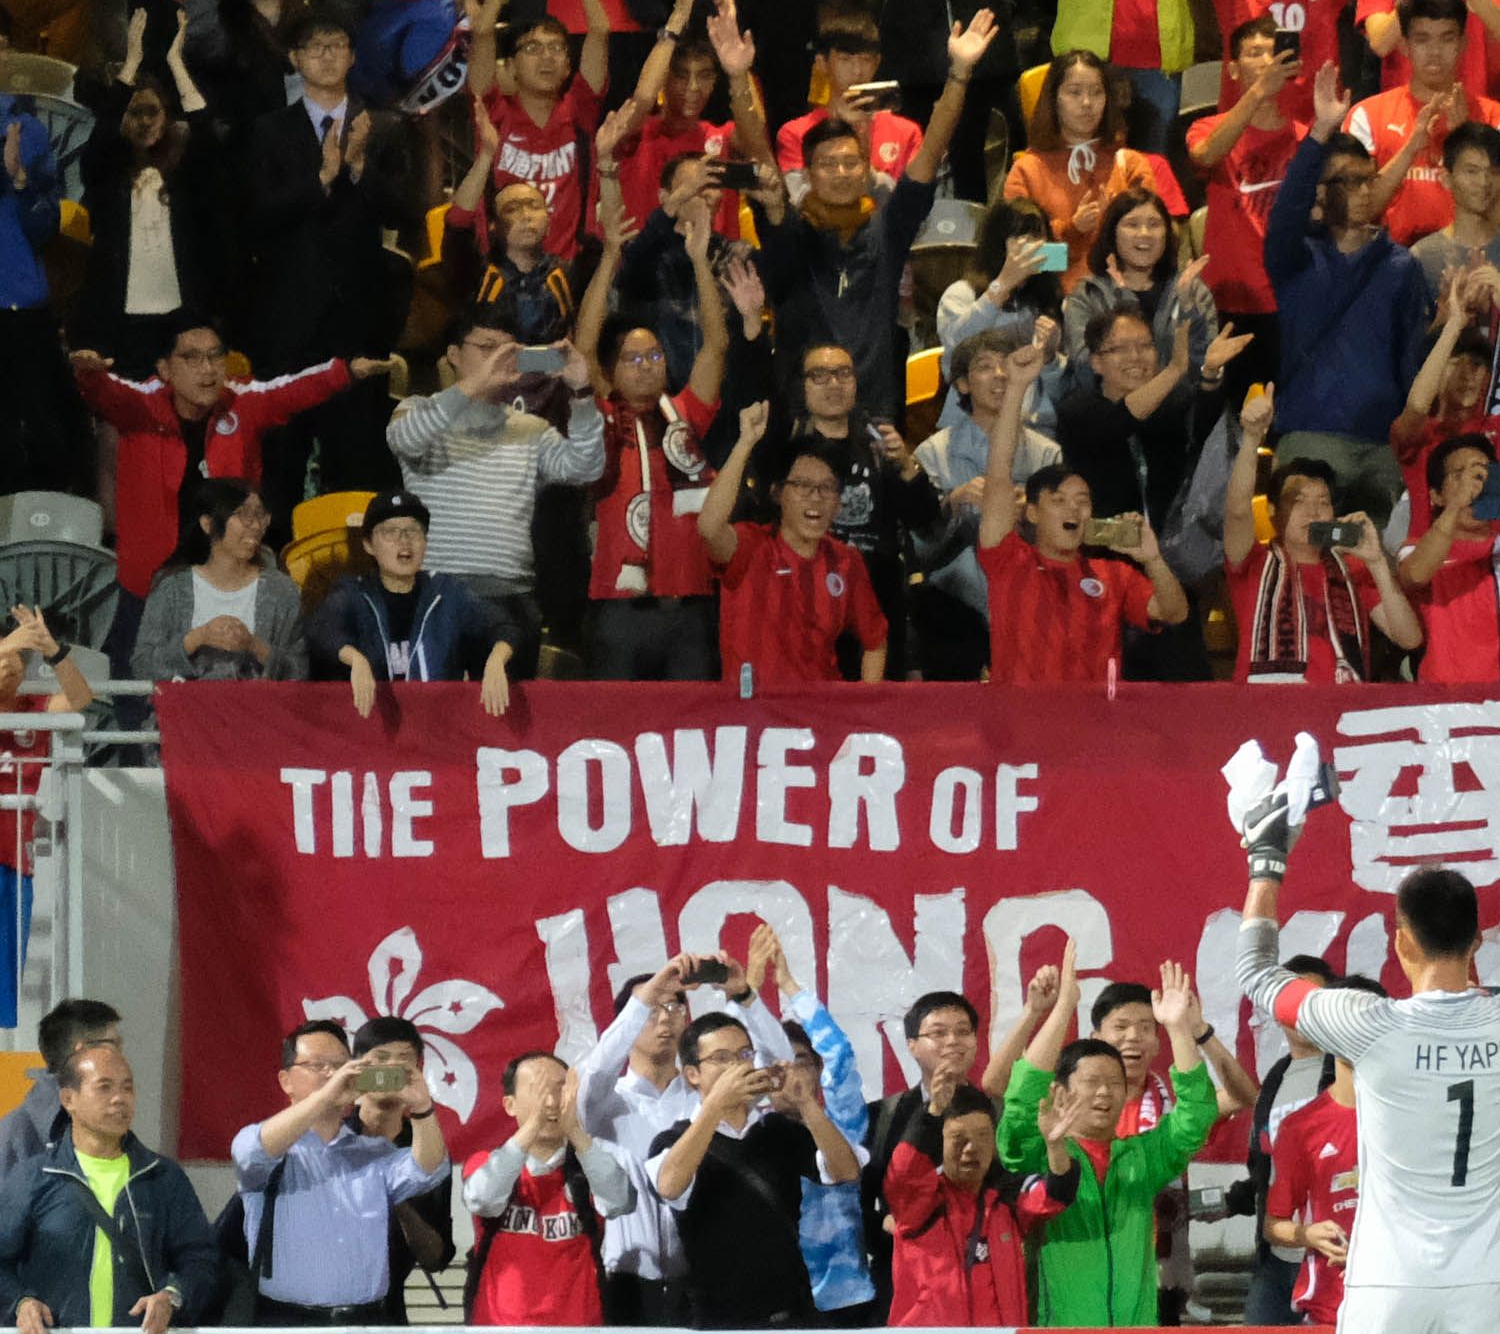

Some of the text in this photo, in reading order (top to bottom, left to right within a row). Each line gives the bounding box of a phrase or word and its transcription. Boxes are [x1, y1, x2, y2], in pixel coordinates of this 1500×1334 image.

[476, 725, 906, 859] POWER
[929, 763, 1039, 854] OF
[1415, 1044, 1448, 1072] HF
[1446, 1078, 1477, 1188] 1
